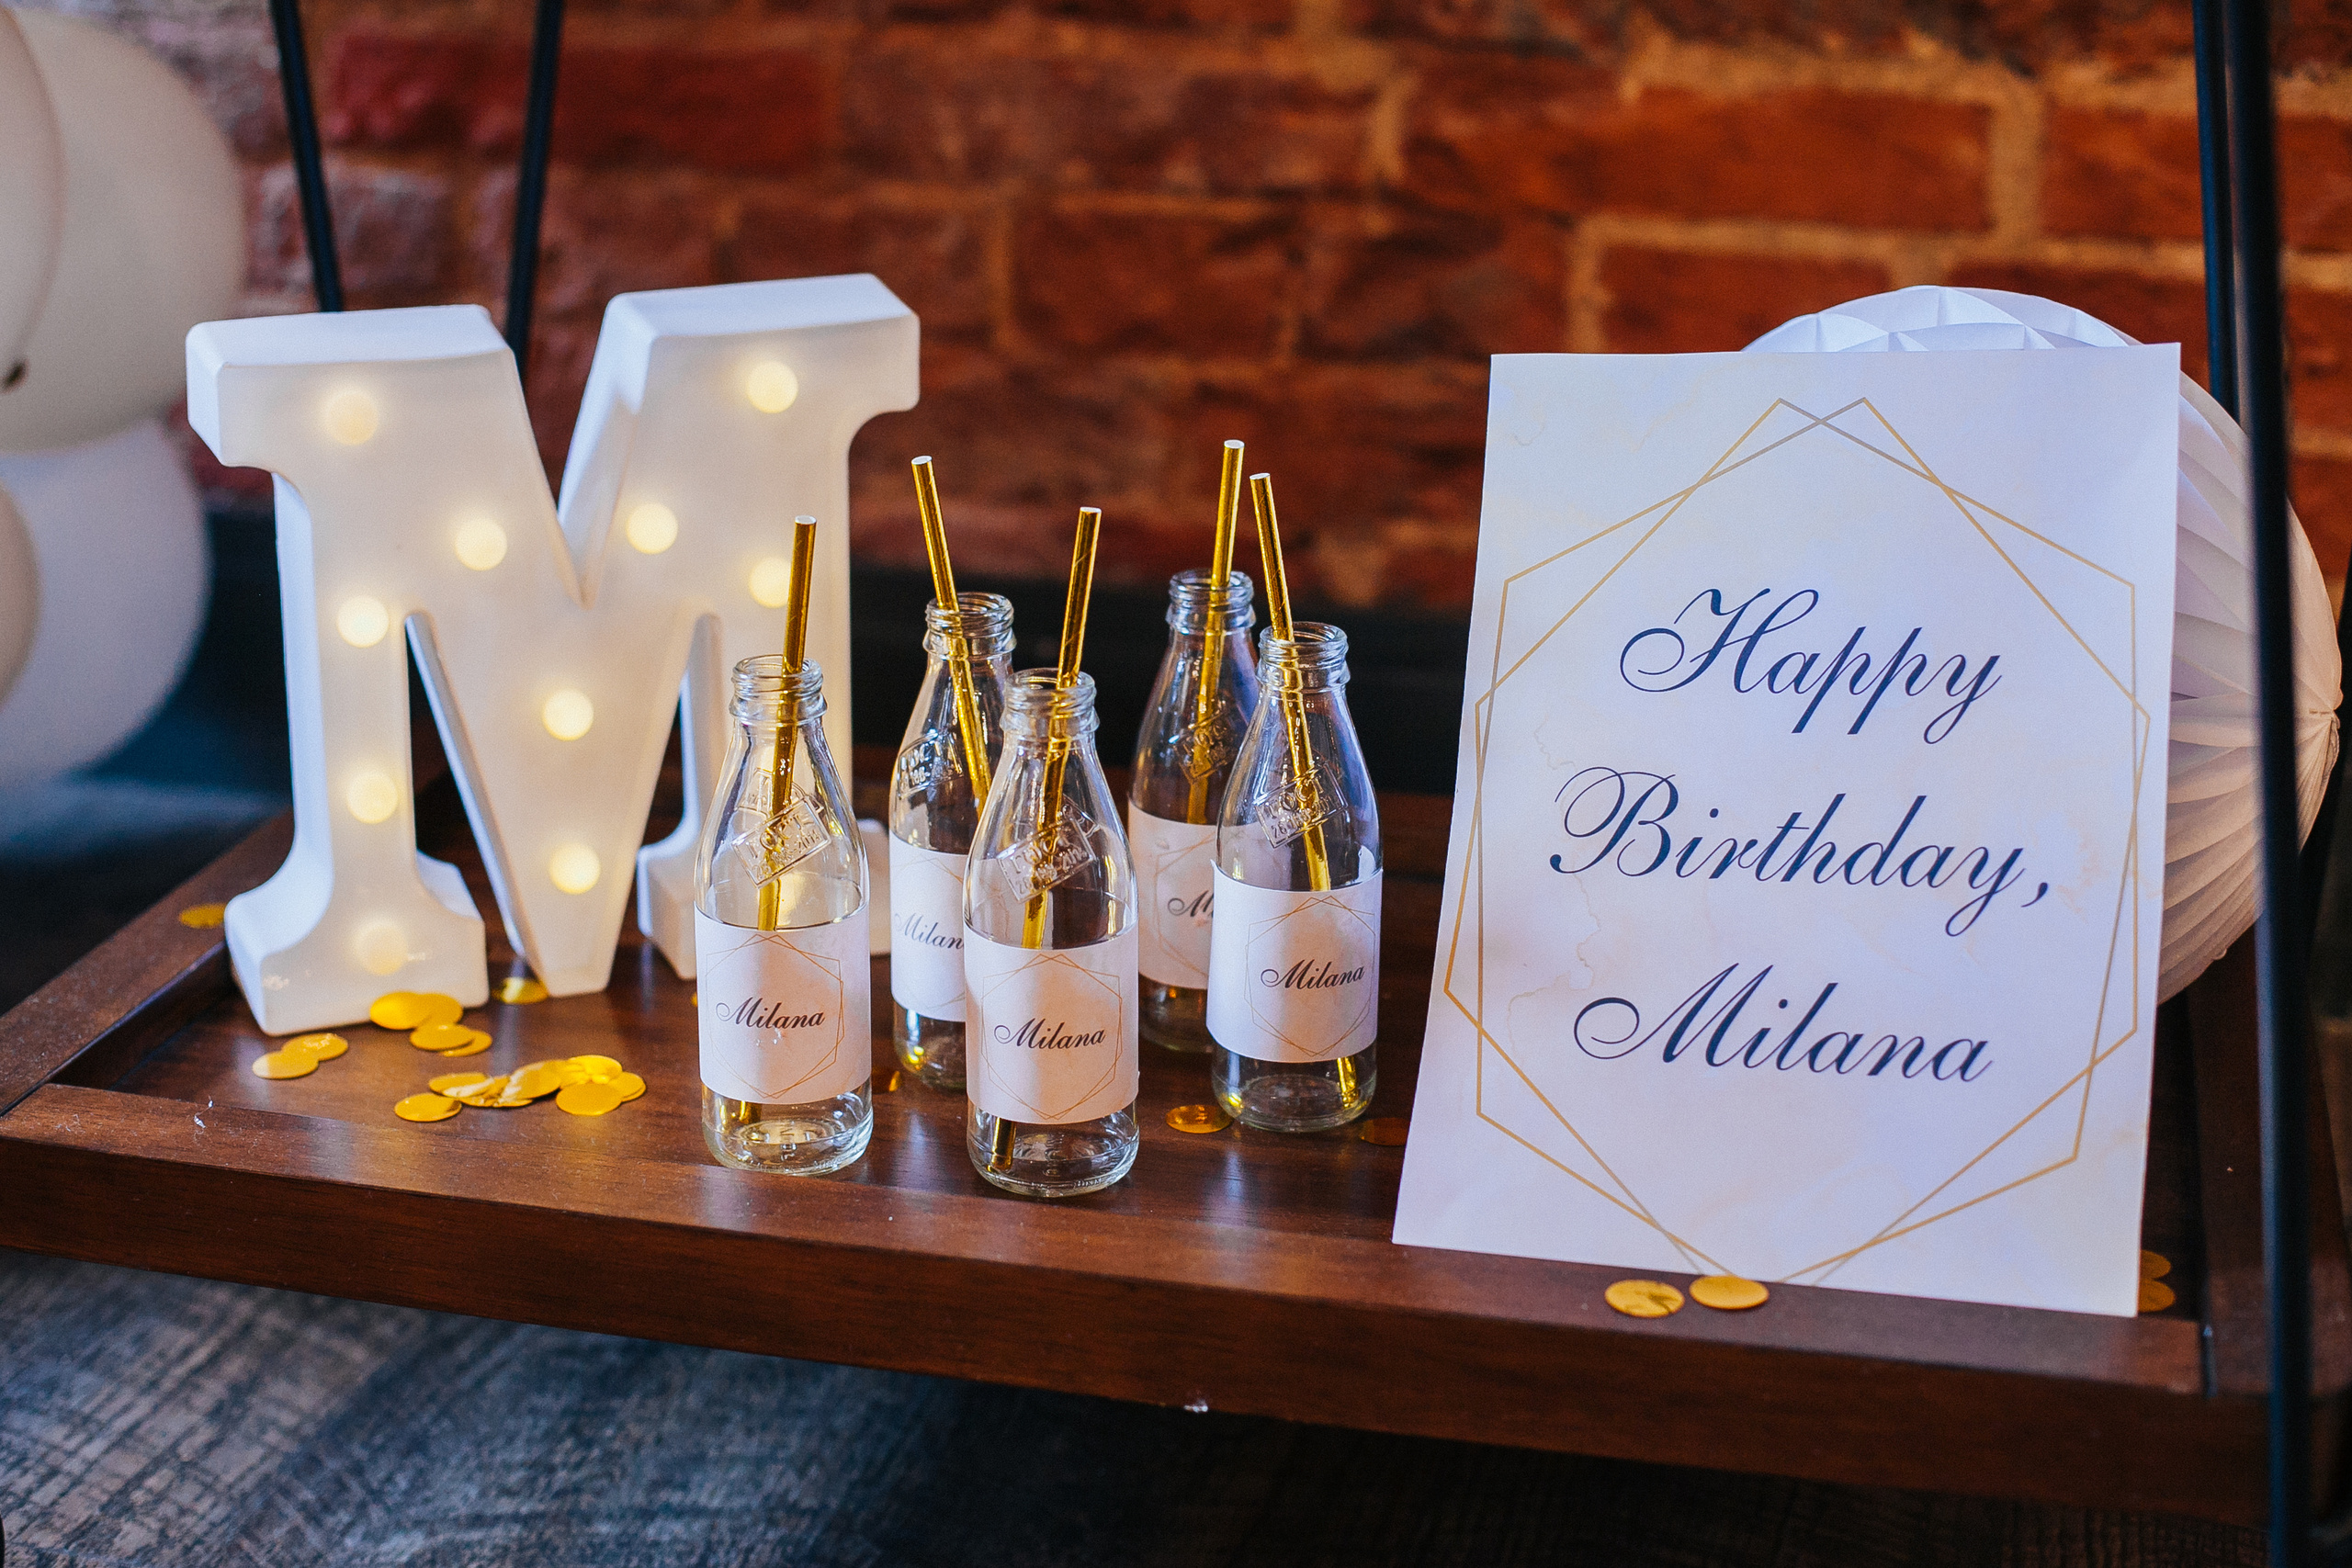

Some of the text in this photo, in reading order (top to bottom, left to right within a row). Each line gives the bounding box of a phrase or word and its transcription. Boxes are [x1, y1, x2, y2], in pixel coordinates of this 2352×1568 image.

[1619, 588, 2001, 744] Happy
[1549, 766, 2050, 937] Birthday,
[895, 913, 964, 949] Milan
[1260, 959, 1364, 989] Milana
[716, 997, 825, 1029] Milana
[1573, 963, 1993, 1082] Milana
[993, 1018, 1105, 1049] Milana
